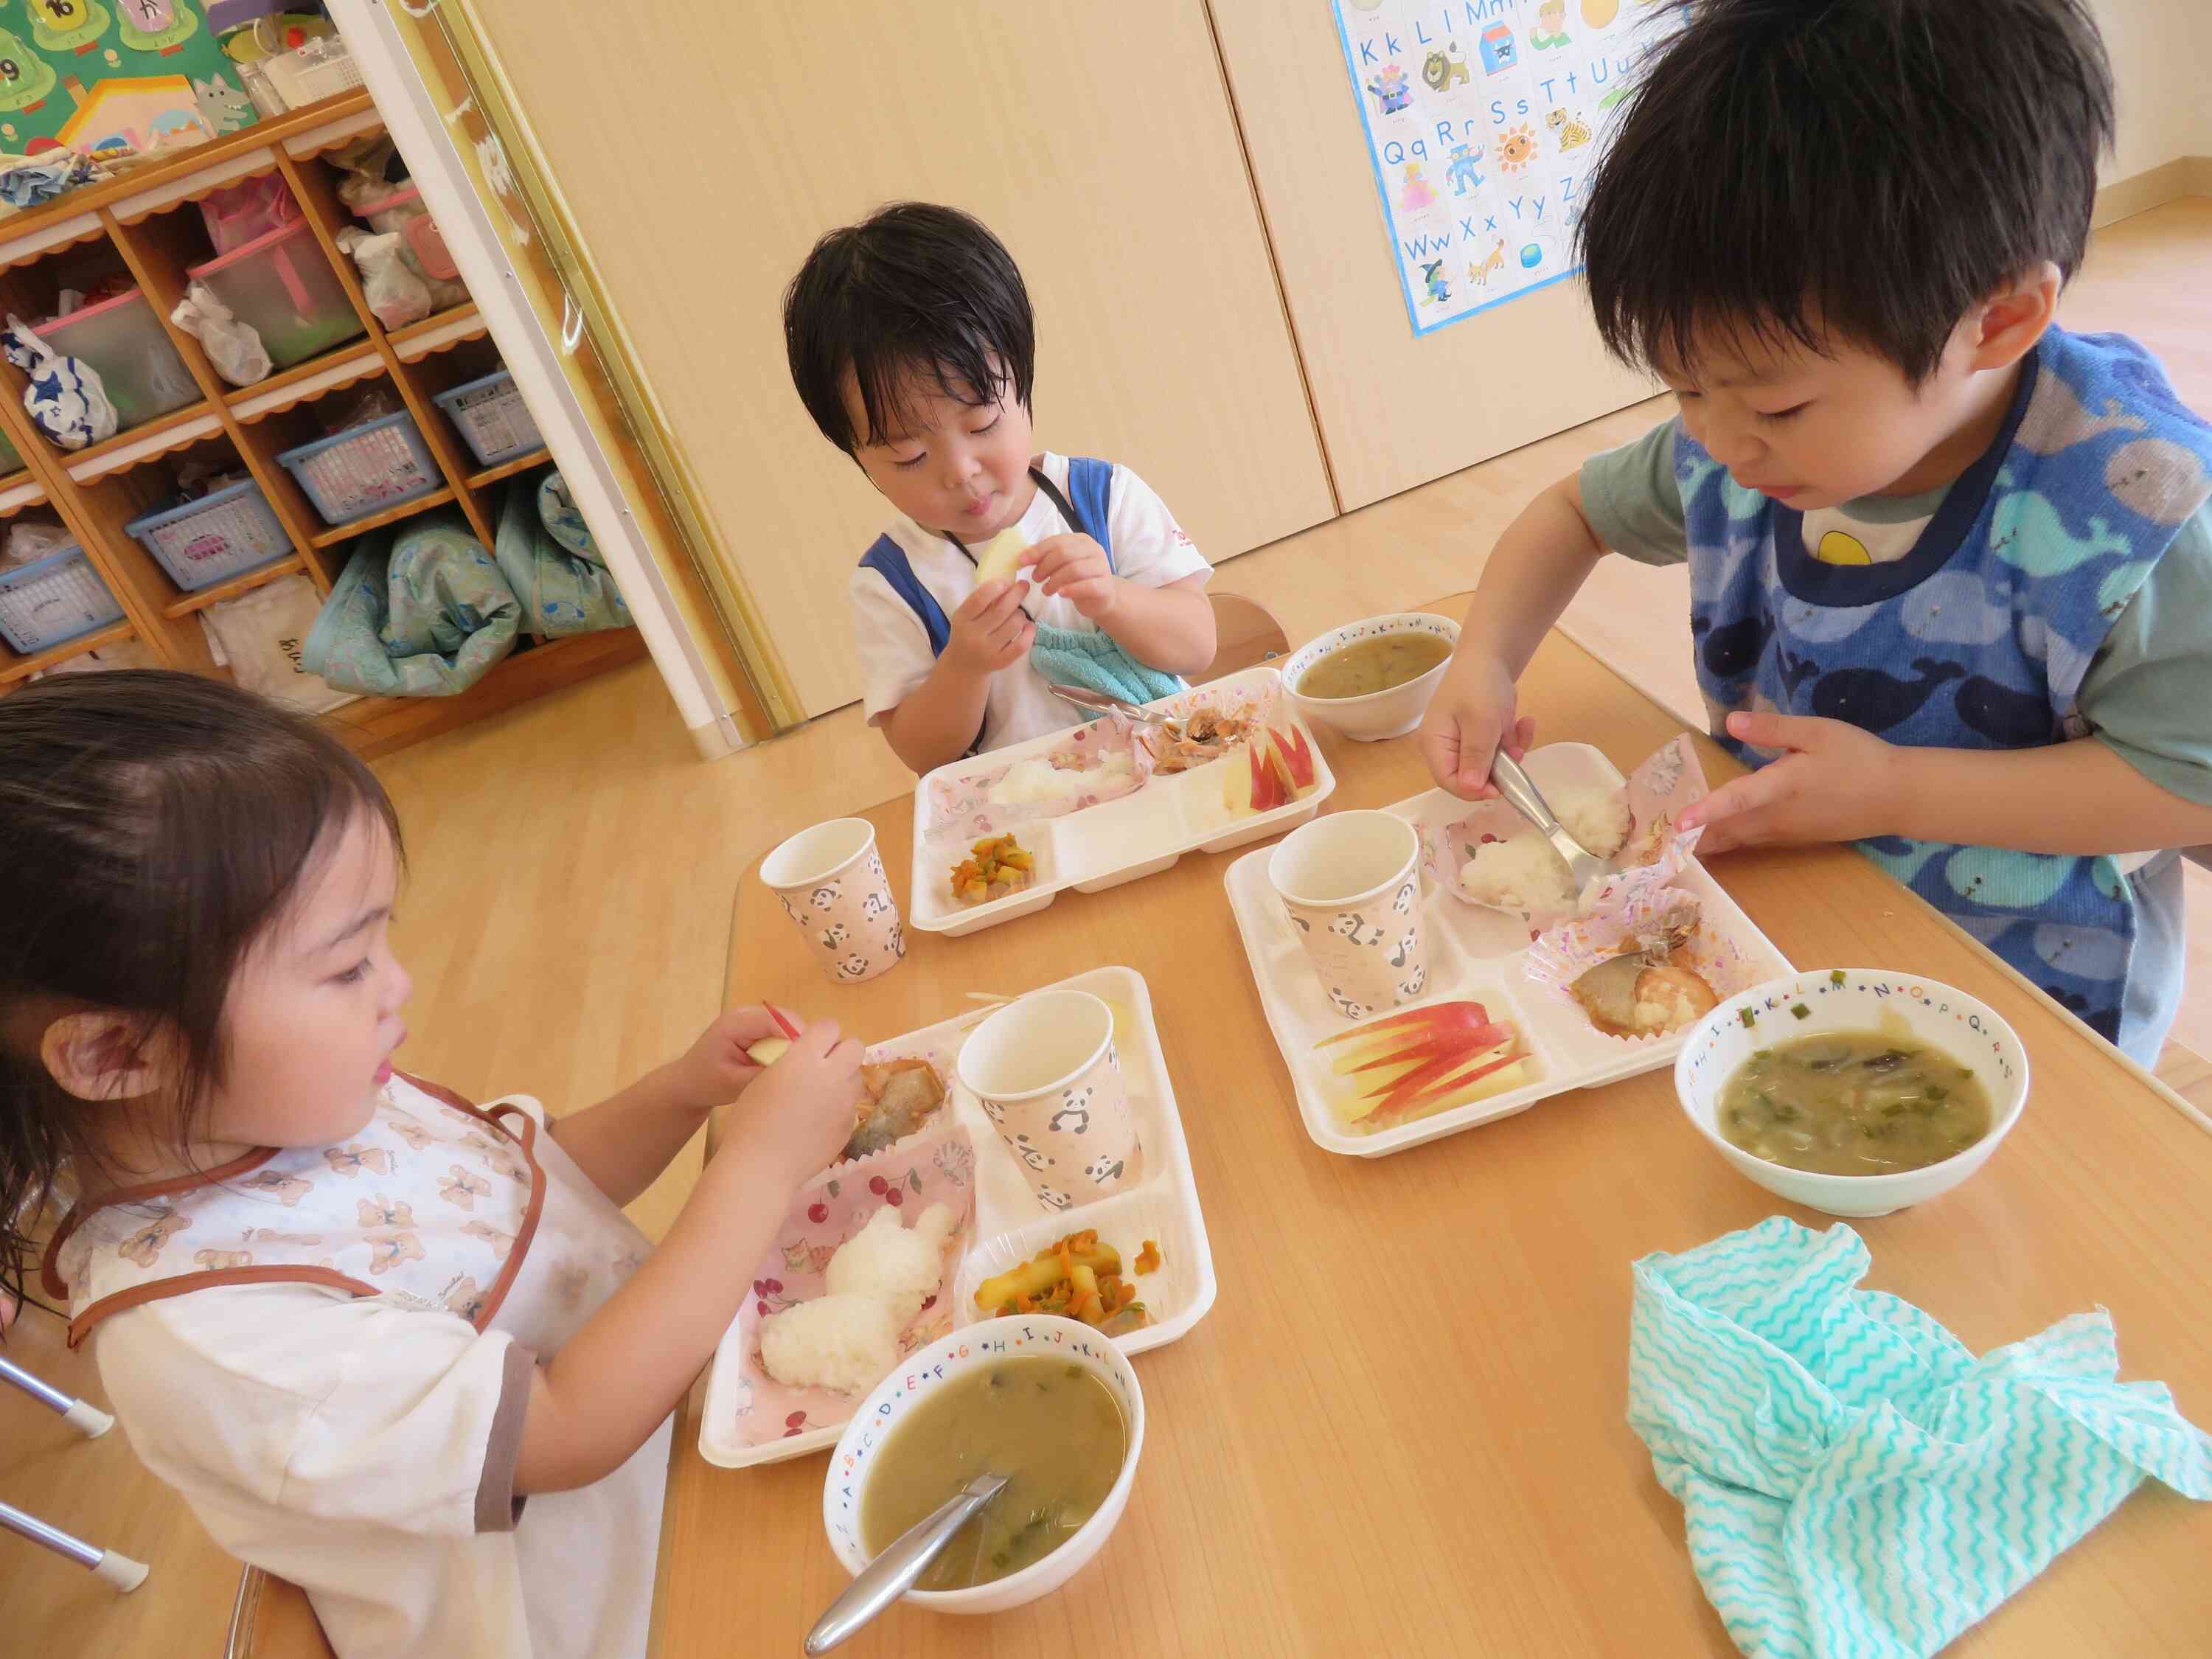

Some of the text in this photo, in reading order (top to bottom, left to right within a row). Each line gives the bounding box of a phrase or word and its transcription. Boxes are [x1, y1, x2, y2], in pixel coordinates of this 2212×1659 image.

[1379, 625, 1387, 633] K
[1710, 1024, 1722, 1037] I
[1794, 981, 1806, 995] L
[1874, 982, 1891, 998] N
[1910, 985, 1924, 998] O
[1938, 1003, 1949, 1014] P
[1968, 1015, 1981, 1033] Q
[1022, 1326, 1034, 1341] I
[1054, 1330, 1063, 1344] J
[959, 1344, 970, 1358] G
[994, 1340, 1006, 1352] H
[1082, 1343, 1092, 1357] K
[933, 1364, 944, 1380] F
[907, 1374, 917, 1391] E
[878, 1402, 891, 1416] D
[863, 1433, 873, 1448] C
[844, 1453, 855, 1468] B
[842, 1486, 853, 1498] A
